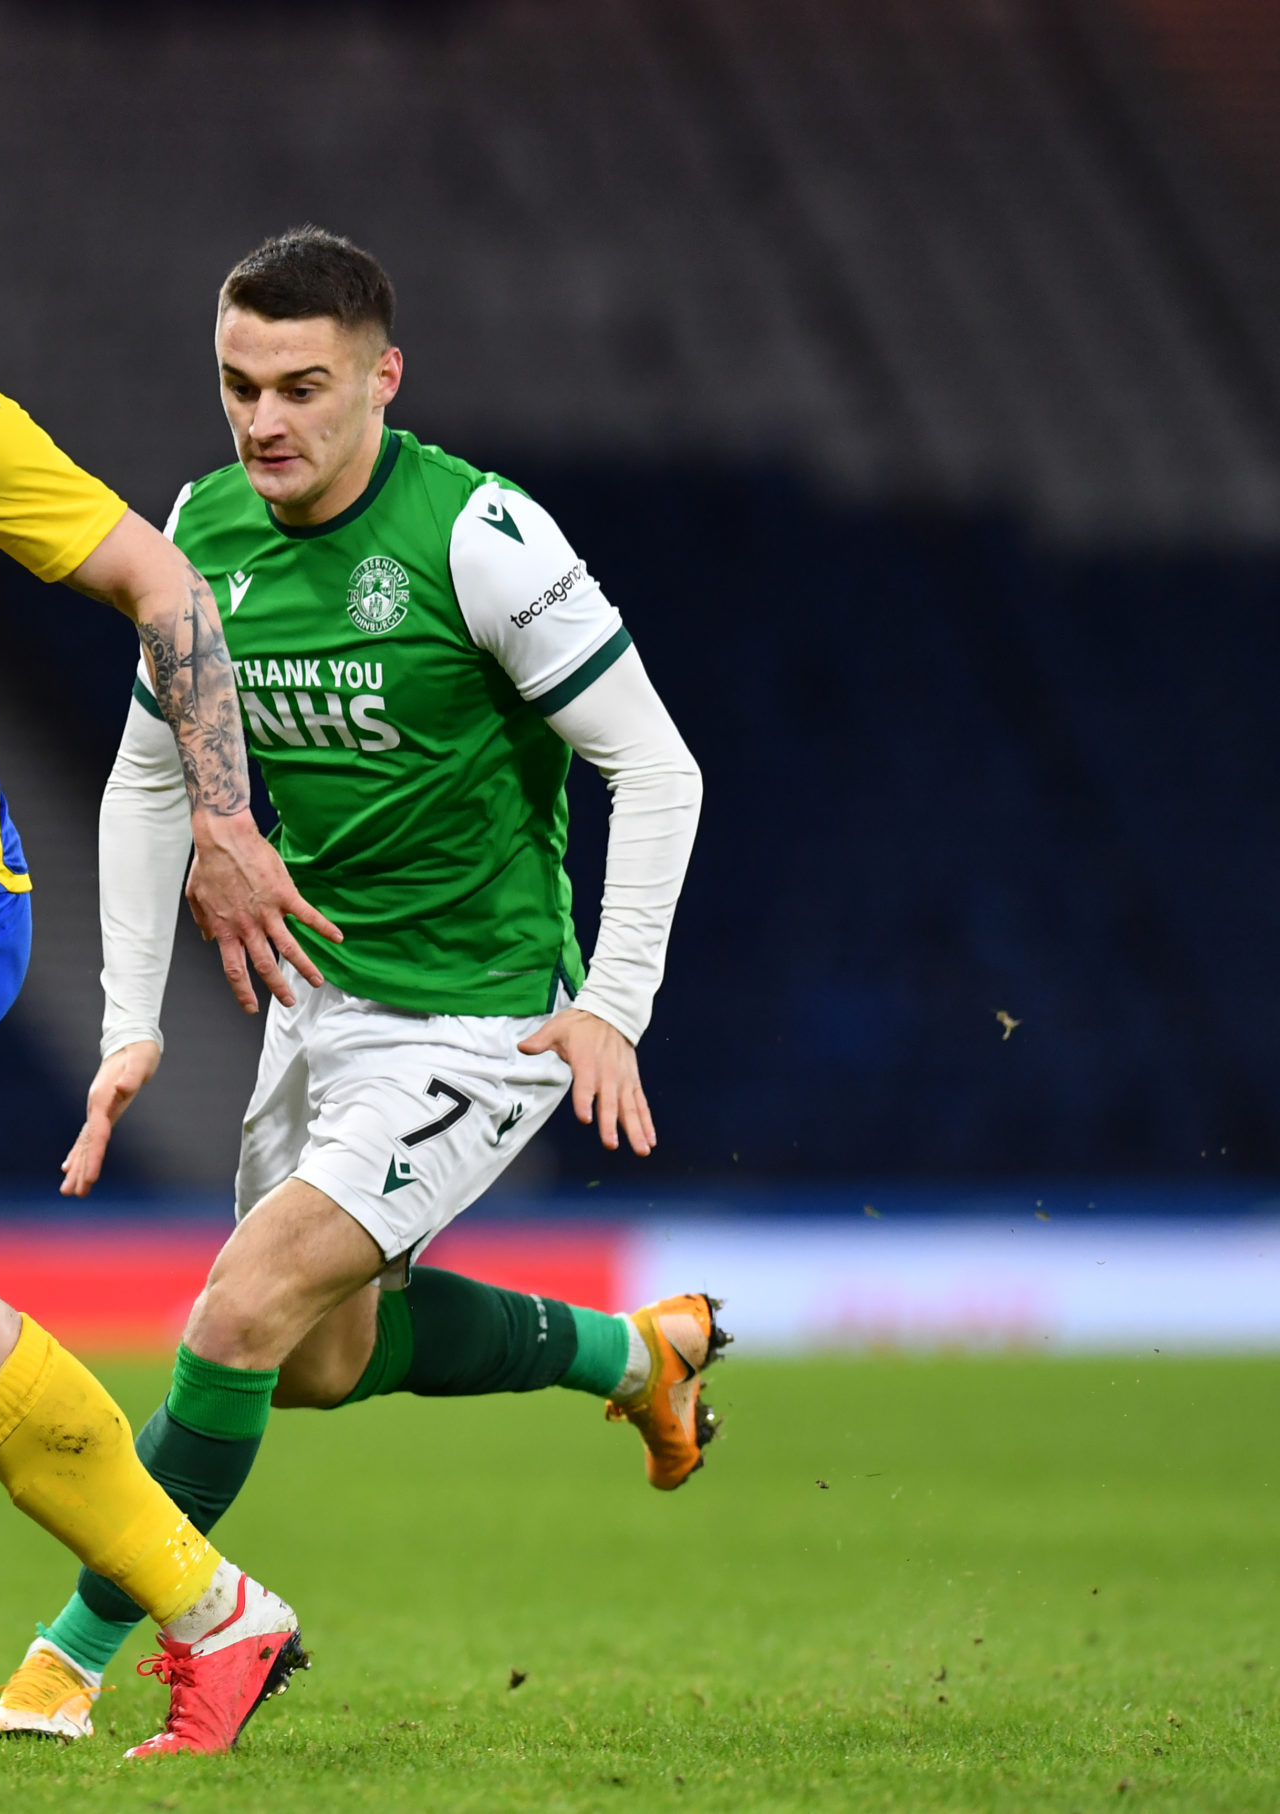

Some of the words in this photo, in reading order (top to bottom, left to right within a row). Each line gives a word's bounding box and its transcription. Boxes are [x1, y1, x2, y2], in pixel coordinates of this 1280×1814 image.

[353, 558, 405, 583] HIBERNIAN
[510, 561, 586, 629] tec:agency
[350, 609, 402, 632] EDINBURGH
[231, 659, 322, 688] THANK
[327, 660, 383, 690] YOU
[238, 690, 401, 752] NHS
[397, 1075, 475, 1149] 7
